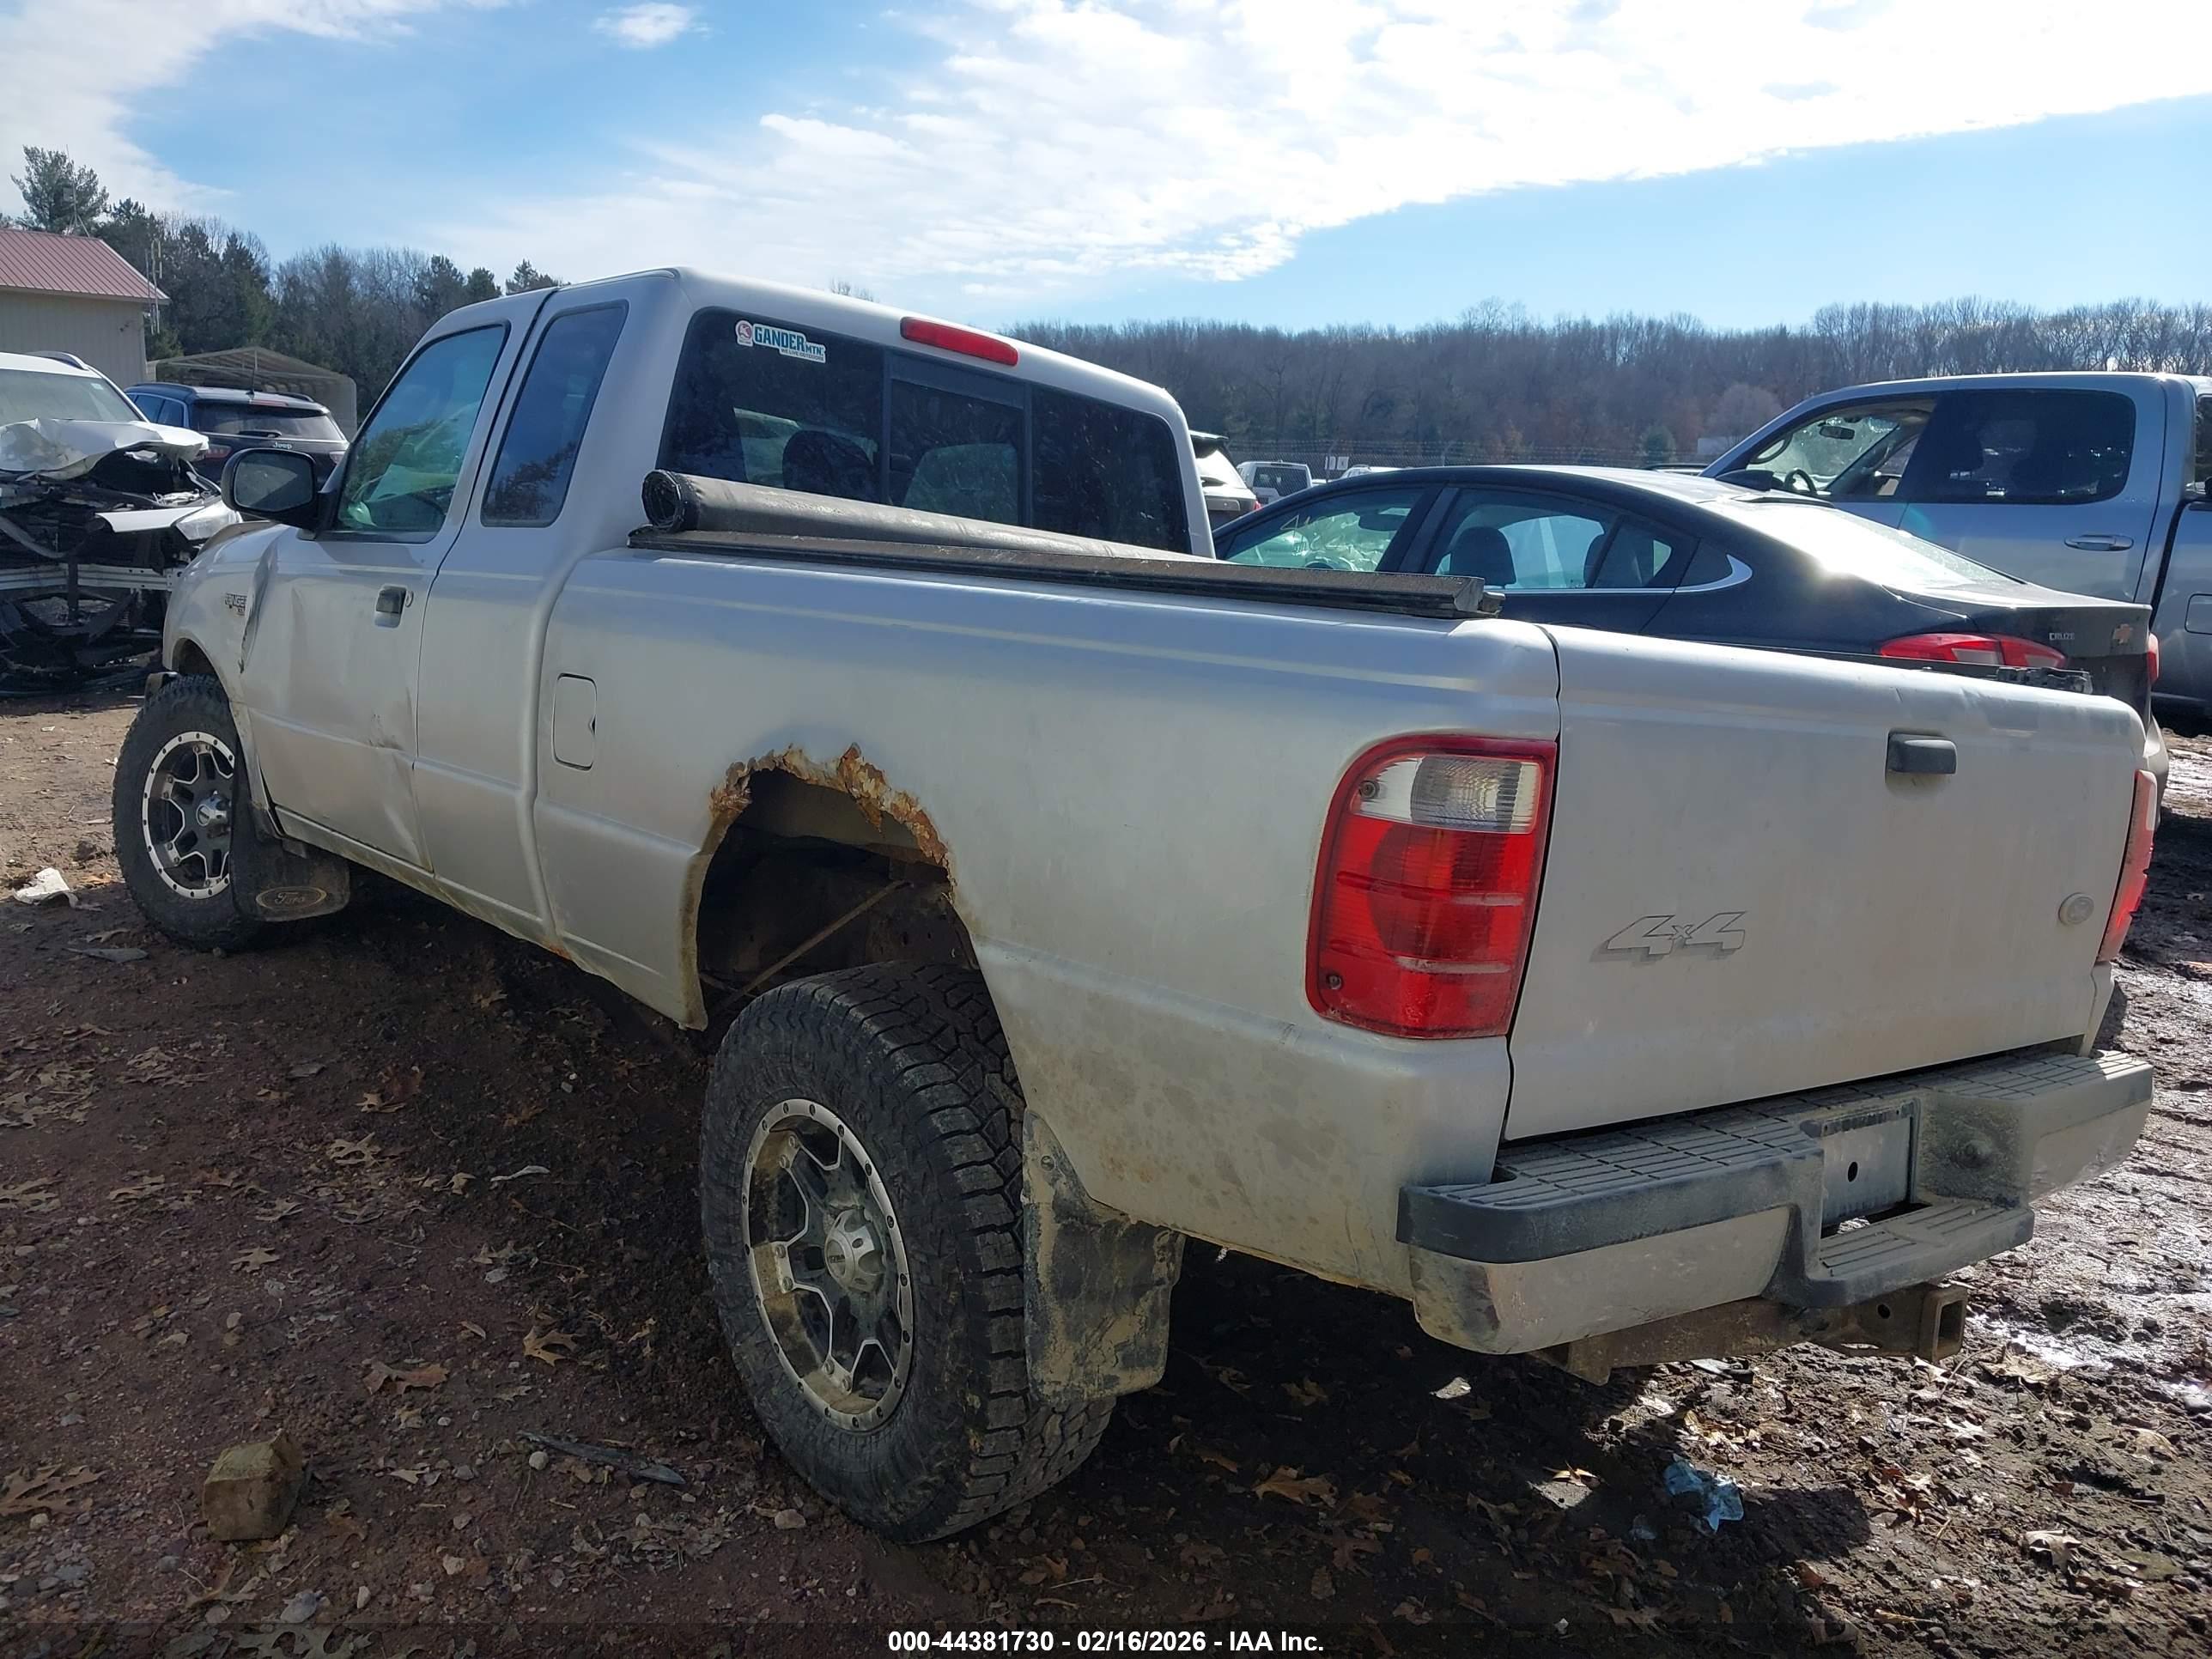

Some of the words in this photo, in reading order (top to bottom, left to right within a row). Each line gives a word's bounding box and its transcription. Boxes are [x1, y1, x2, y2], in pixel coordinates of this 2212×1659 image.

[755, 326, 805, 353] GANDER
[272, 441, 293, 450] Jeep
[2049, 632, 2075, 641] CRUZE
